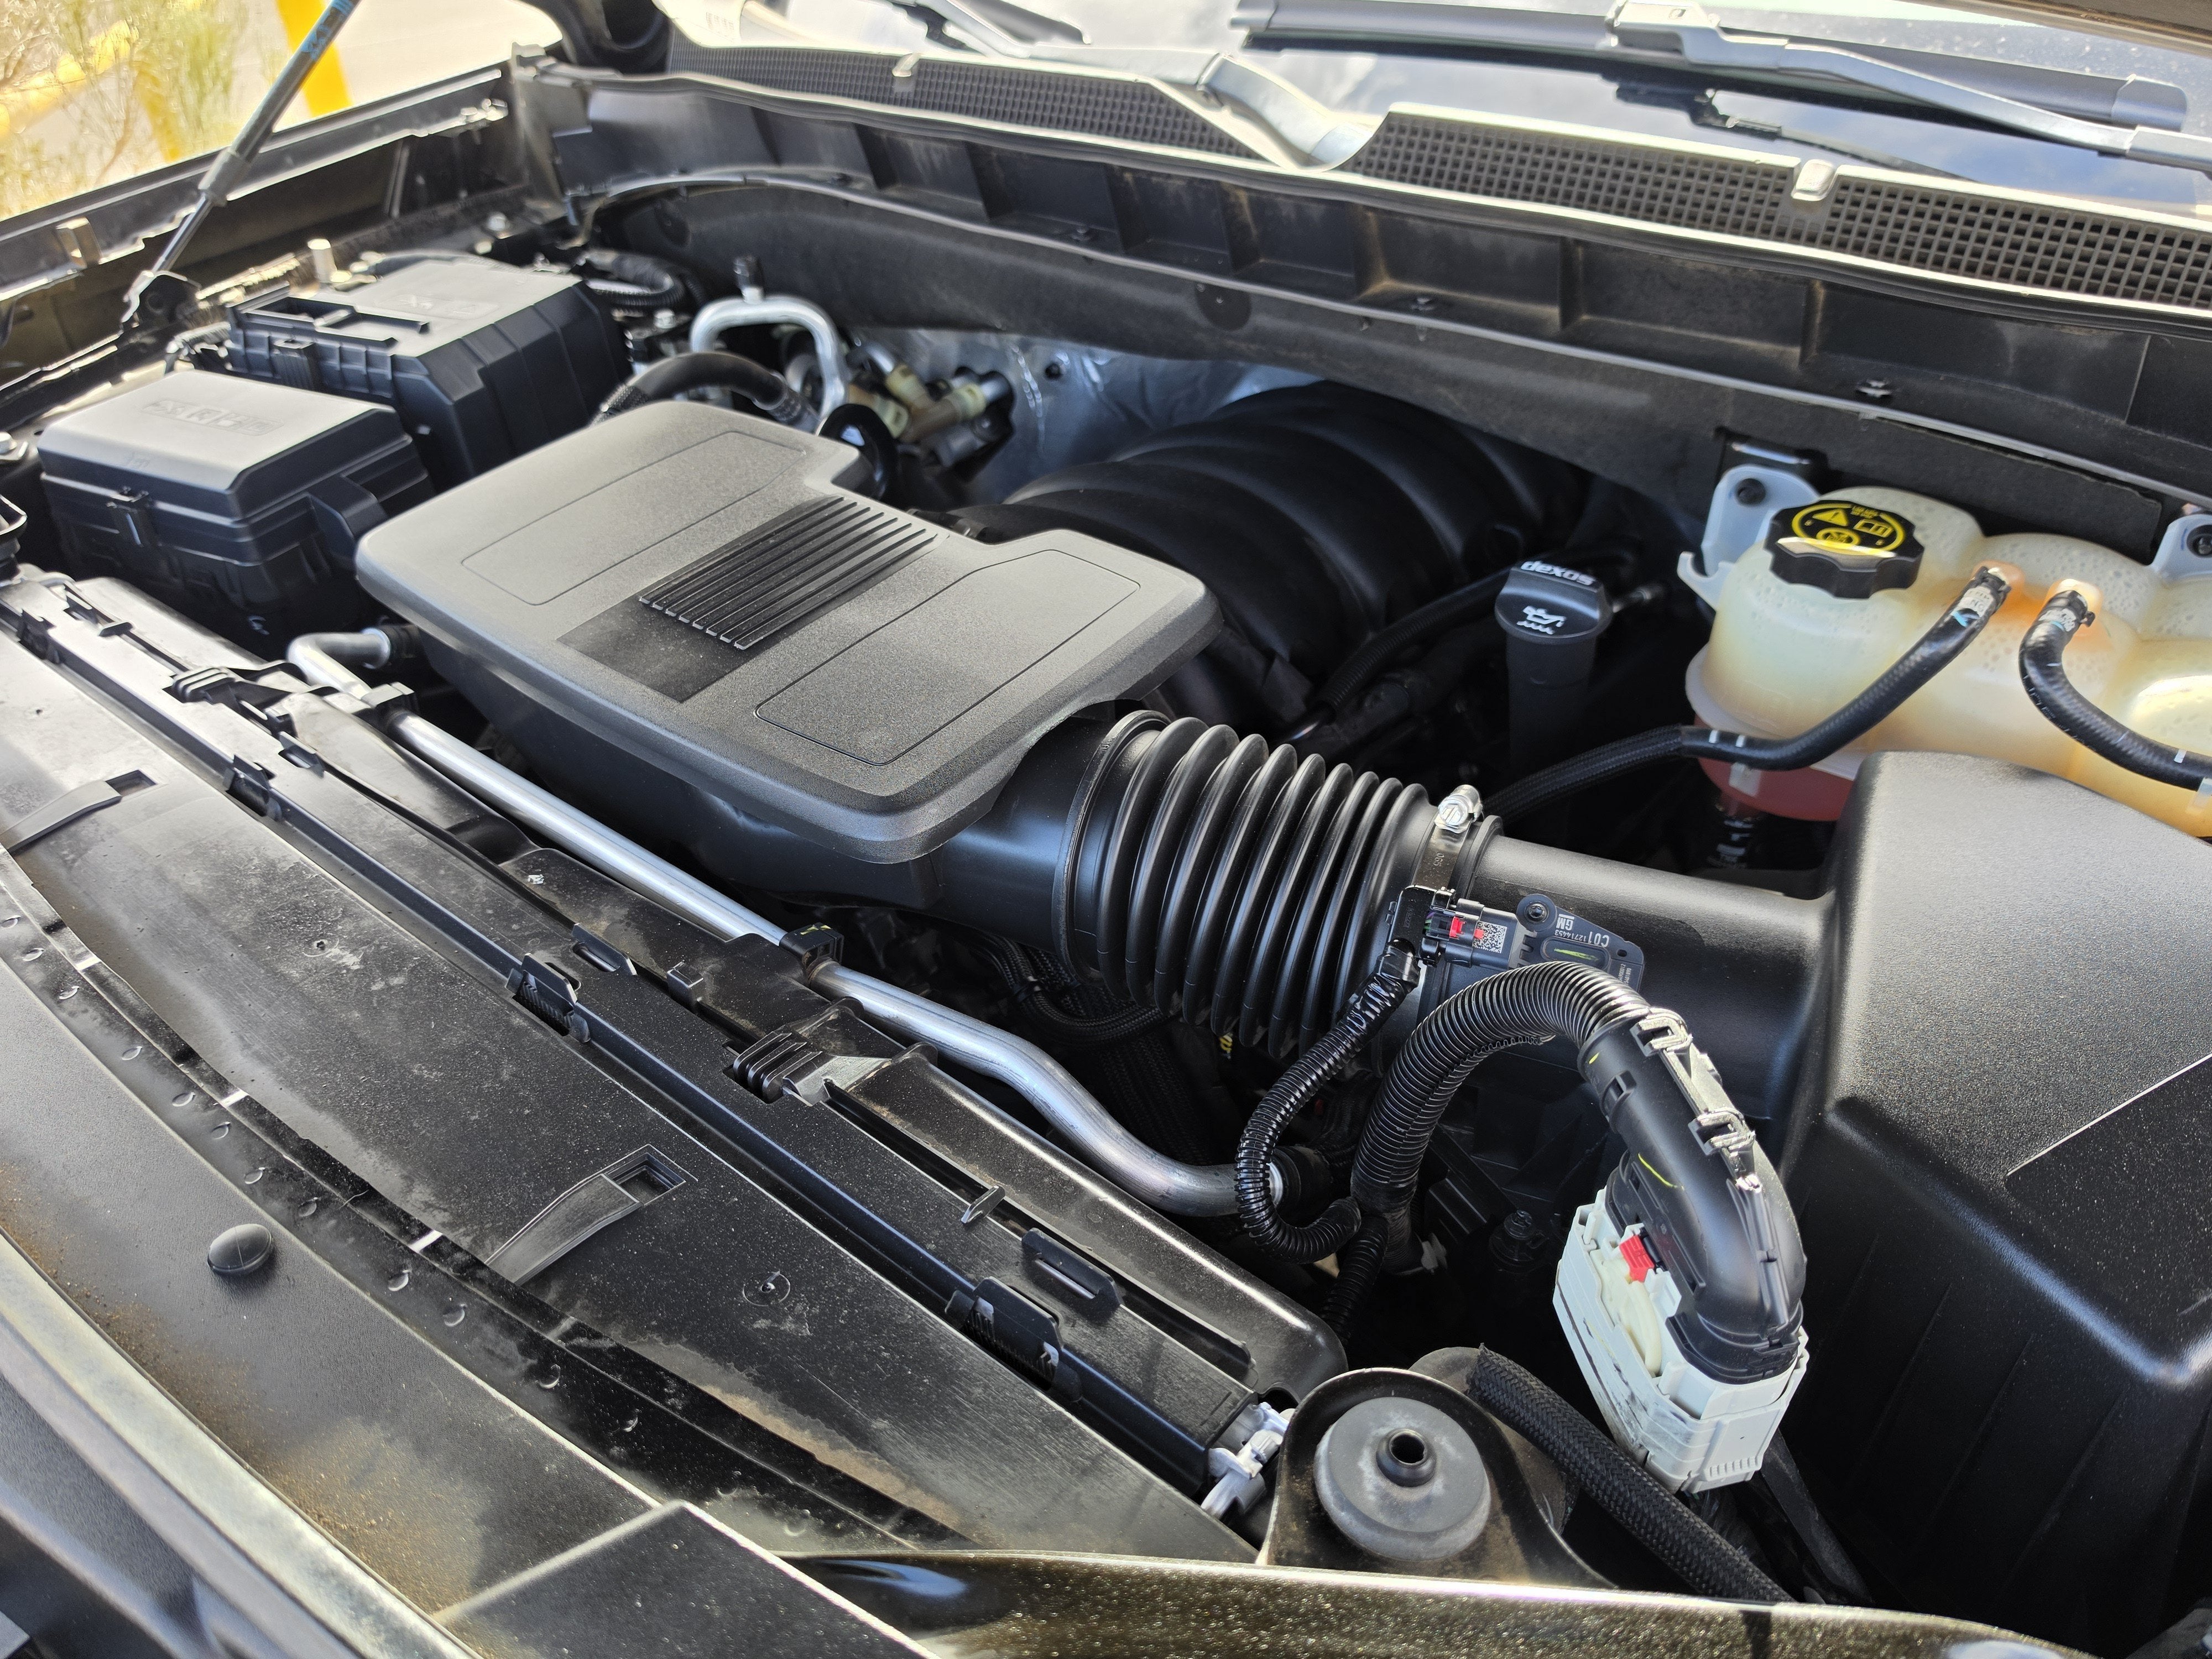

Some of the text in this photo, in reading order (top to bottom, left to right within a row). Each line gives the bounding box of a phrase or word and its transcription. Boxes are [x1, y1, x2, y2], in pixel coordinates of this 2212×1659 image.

[1520, 560, 1596, 586] dexos
[1433, 853, 1444, 867] 065
[1556, 916, 1573, 931] GM
[1554, 930, 1587, 942] 12714453
[1588, 931, 1610, 947] C01
